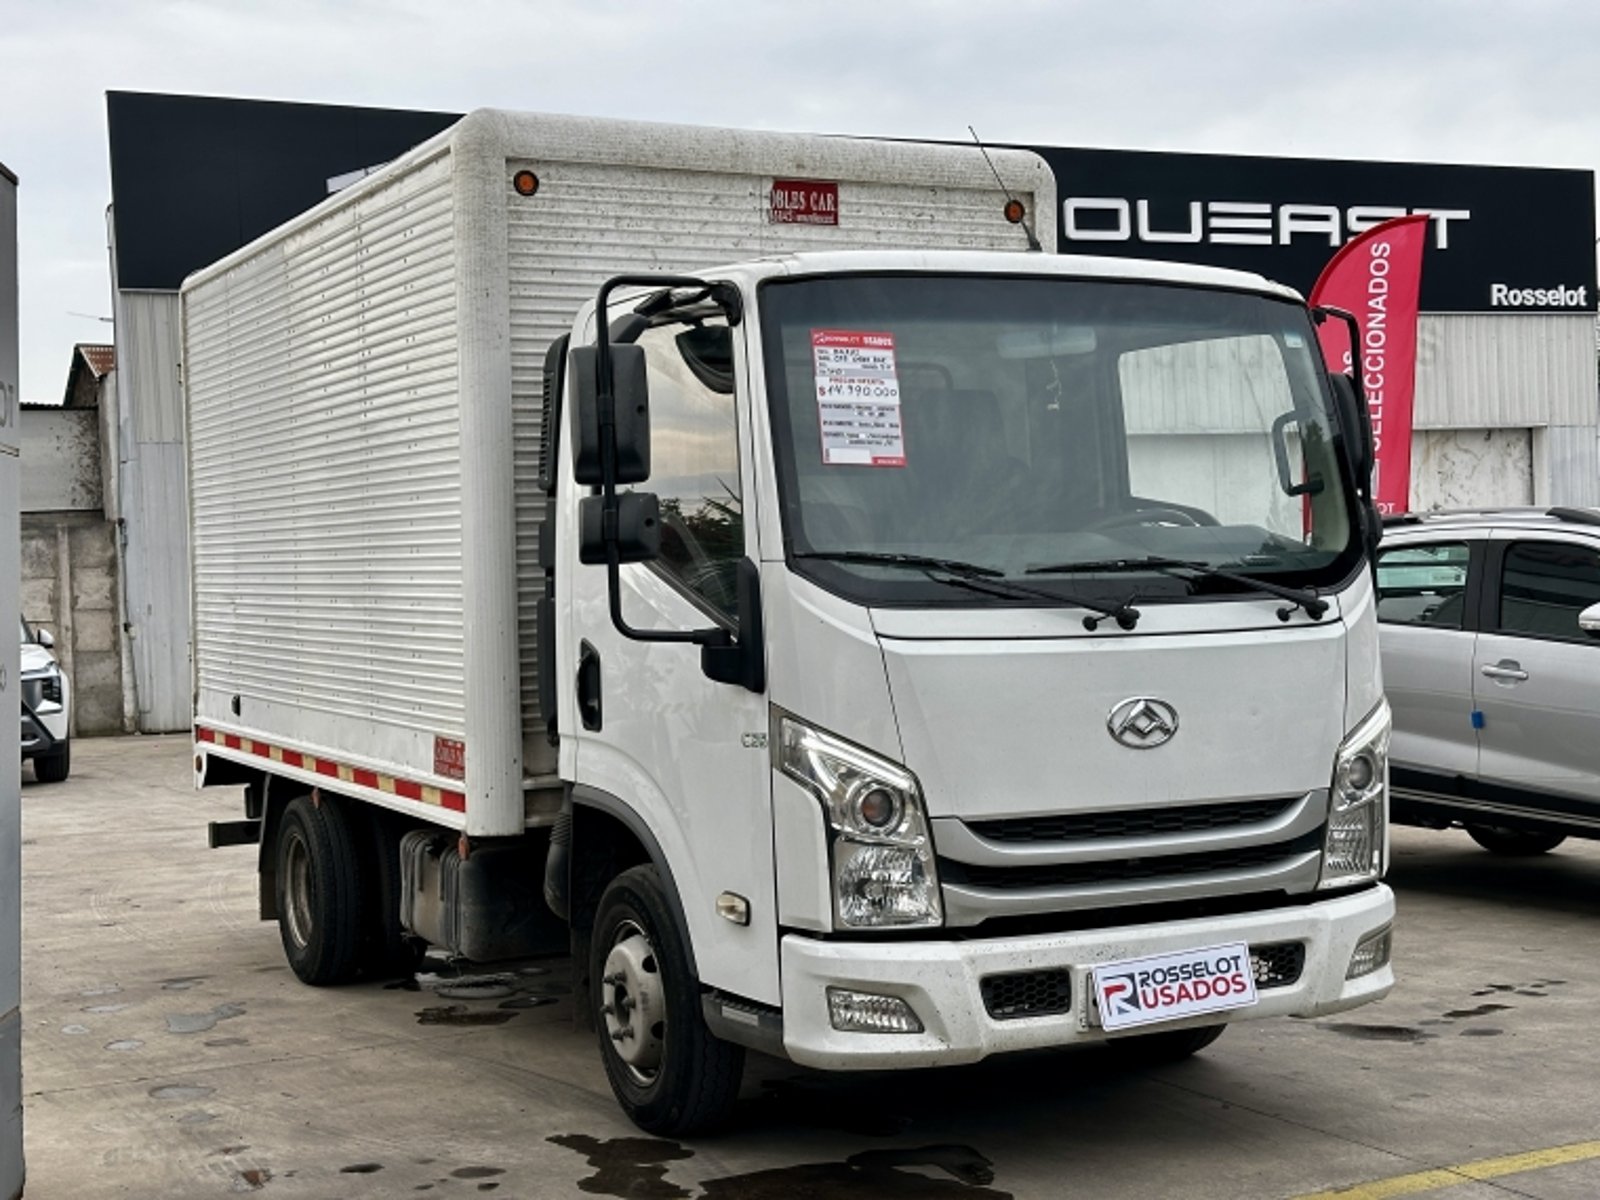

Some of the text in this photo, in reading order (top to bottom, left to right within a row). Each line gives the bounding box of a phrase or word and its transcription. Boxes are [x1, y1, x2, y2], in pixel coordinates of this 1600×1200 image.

[809, 191, 836, 212] CAR
[1490, 282, 1588, 307] Rosselot
[1138, 955, 1241, 988] ROSSELOT
[1141, 973, 1247, 1009] USADOS
